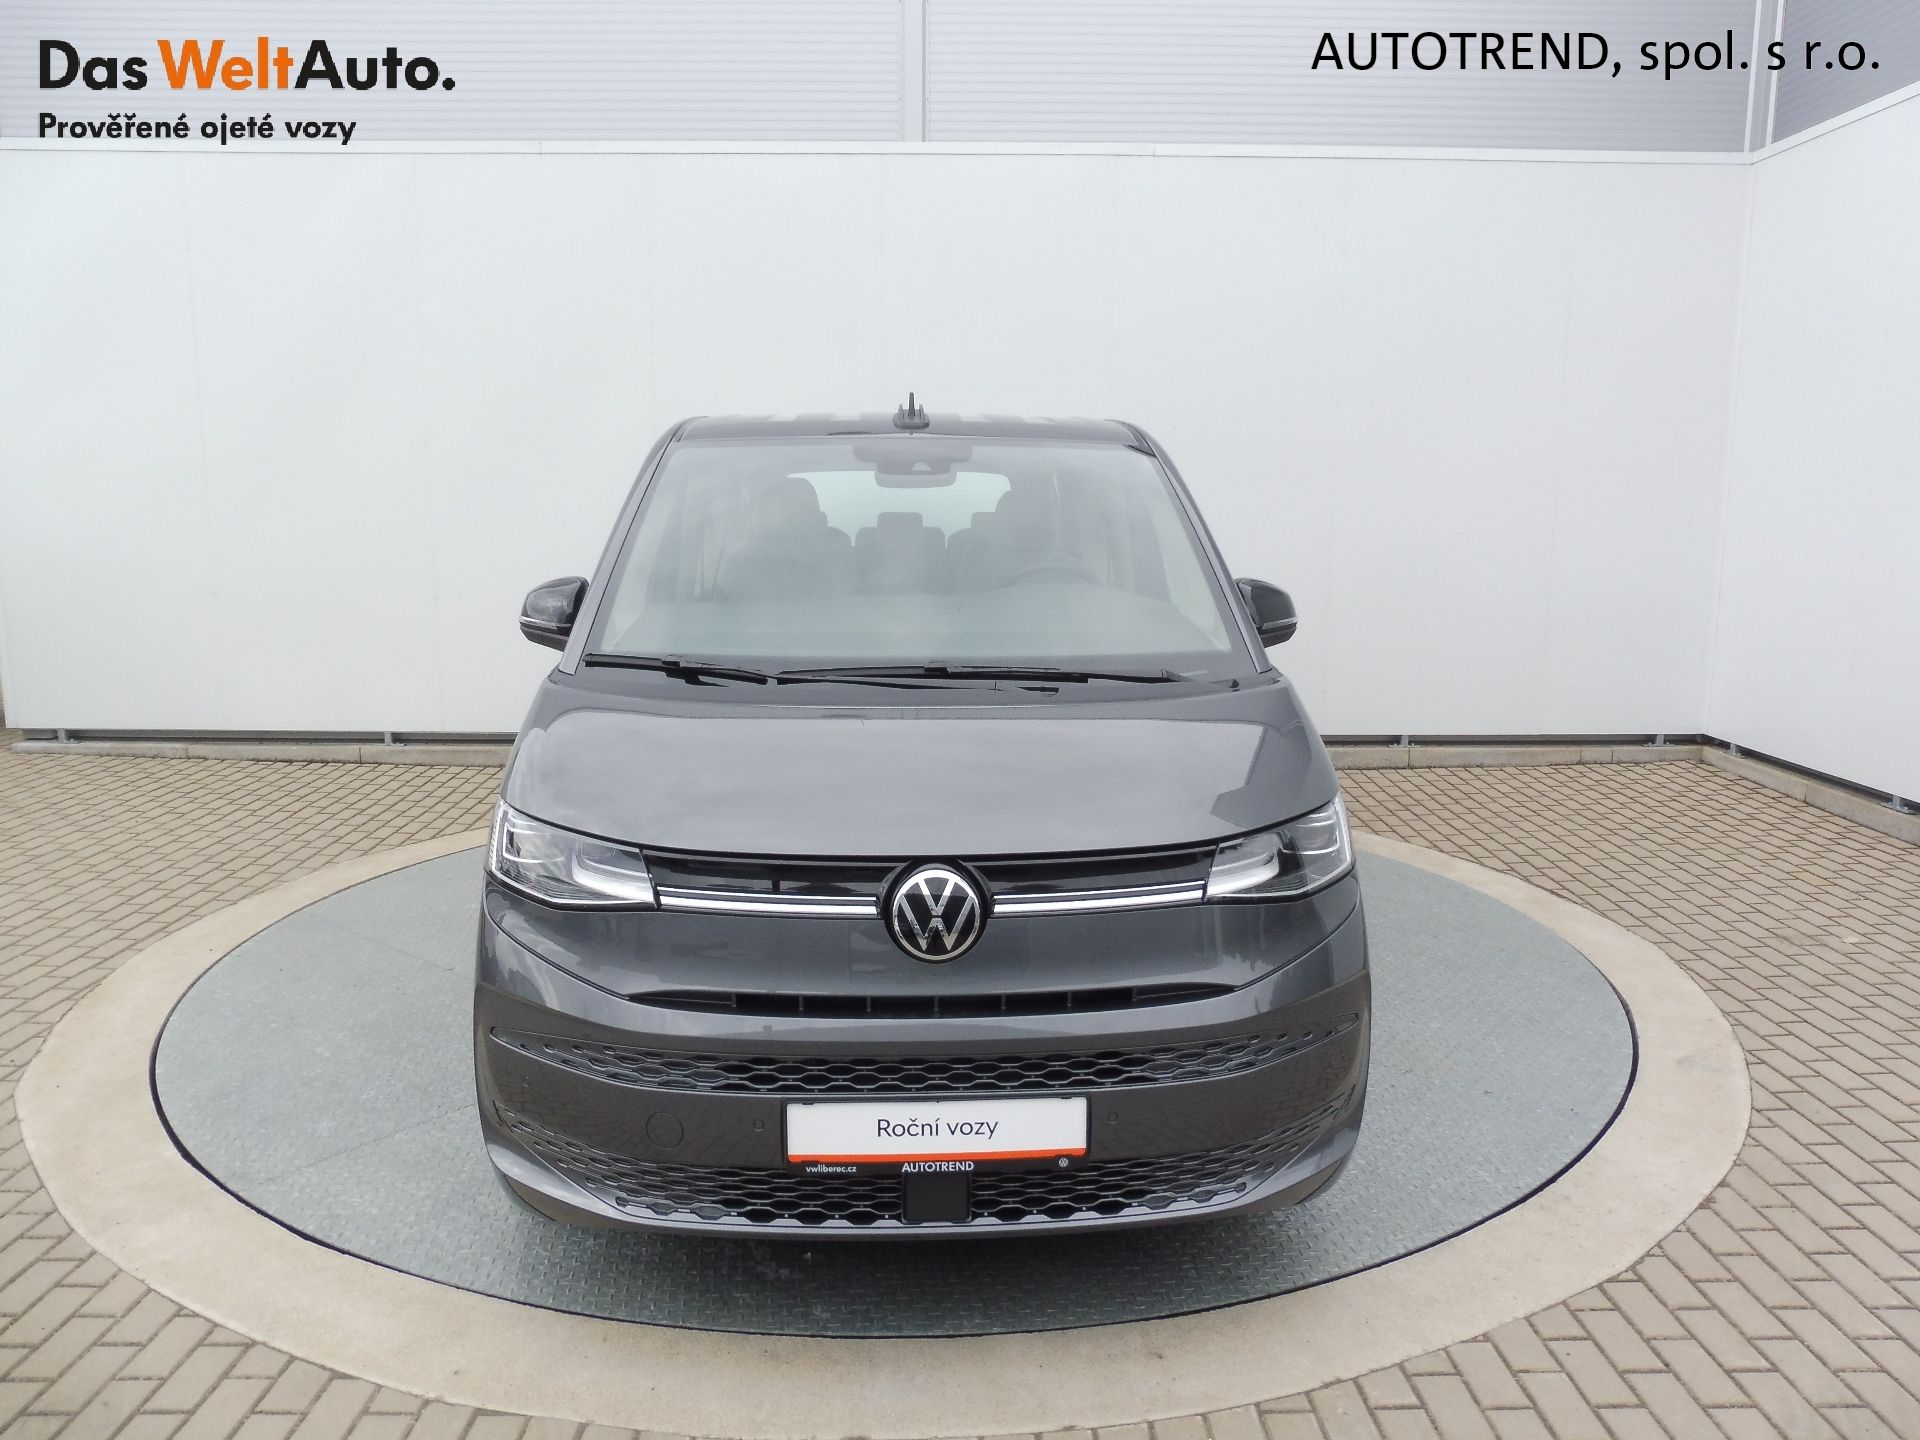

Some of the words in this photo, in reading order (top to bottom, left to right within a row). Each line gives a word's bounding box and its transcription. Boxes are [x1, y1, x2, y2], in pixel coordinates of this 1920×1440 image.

[876, 1118, 940, 1138] Roční
[946, 1120, 999, 1140] vozy
[805, 1165, 857, 1174] vwliberec.cz
[901, 1161, 975, 1173] AUTOTREND
